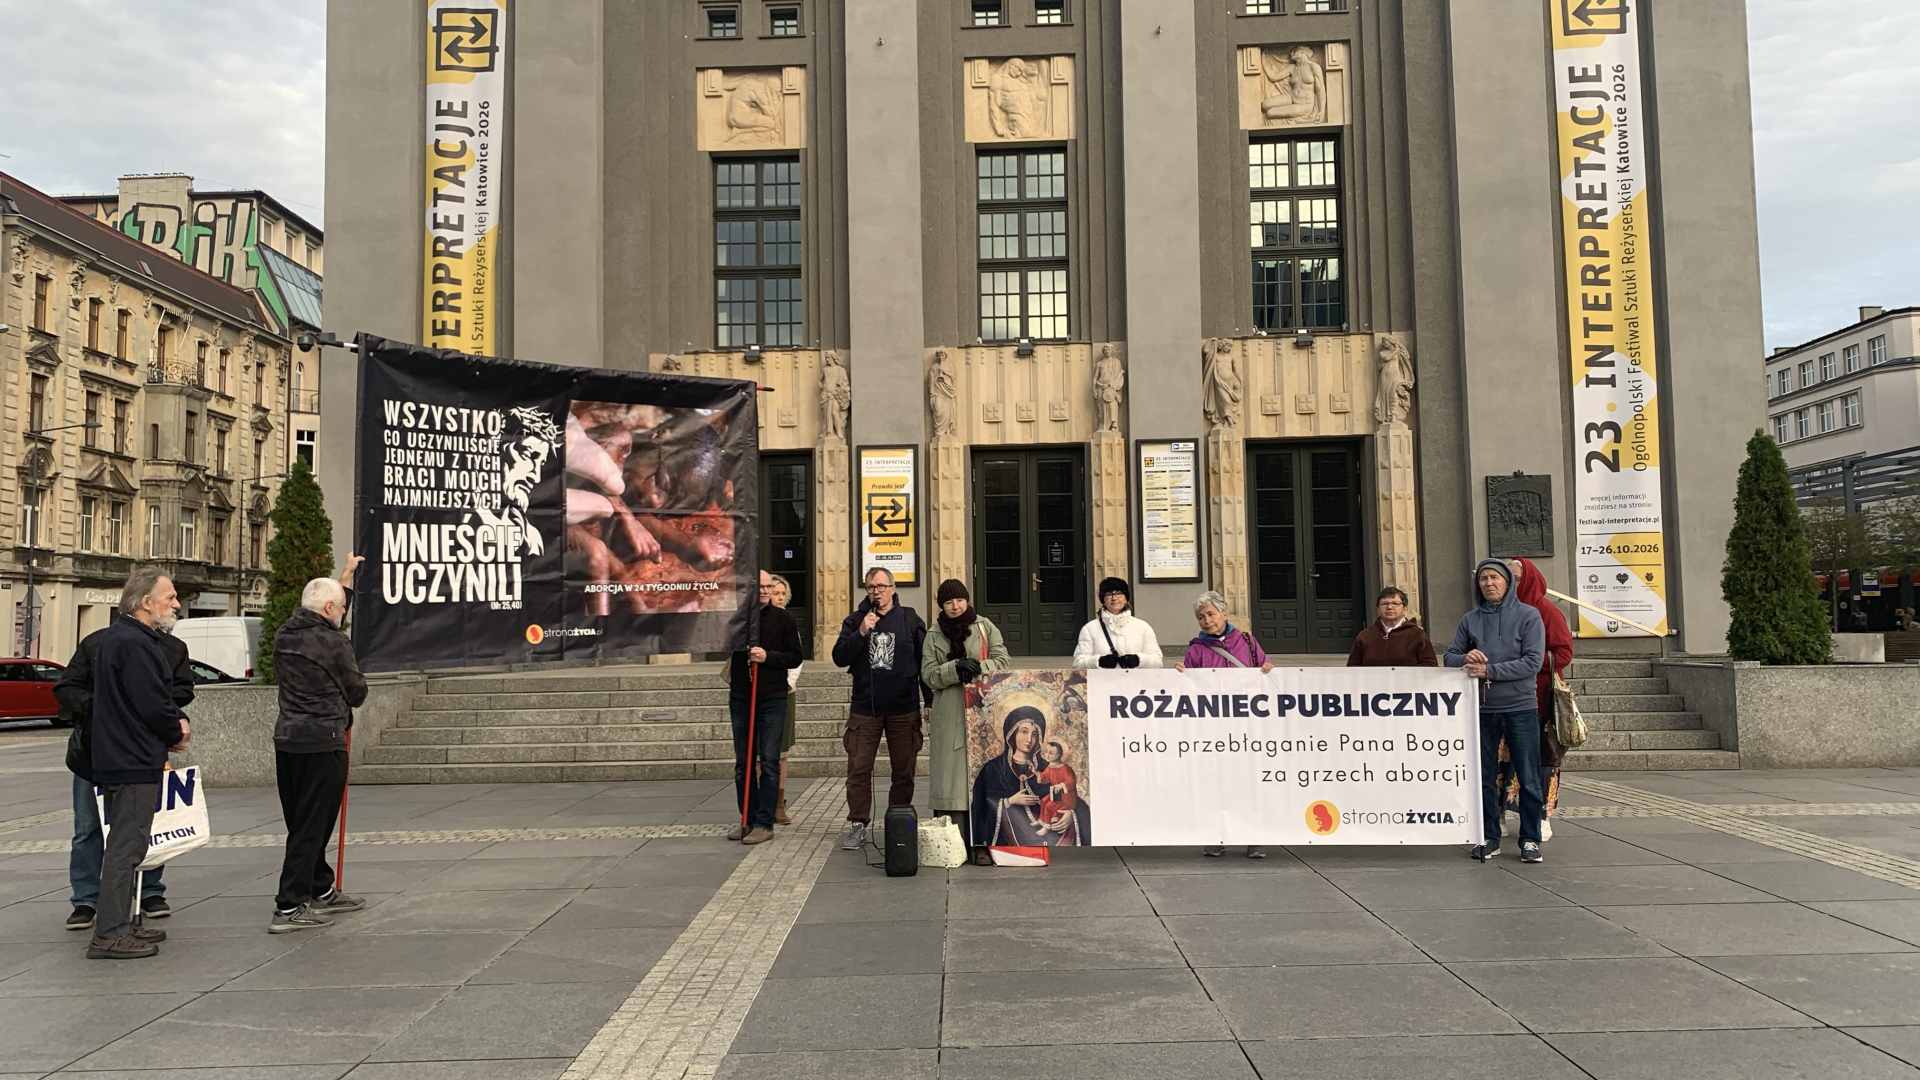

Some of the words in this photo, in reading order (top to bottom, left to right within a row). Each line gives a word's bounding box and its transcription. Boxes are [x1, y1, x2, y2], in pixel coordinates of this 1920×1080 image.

[1612, 64, 1626, 102] 2026
[479, 100, 490, 138] 2026
[1613, 107, 1630, 173] Katowice
[476, 143, 488, 207] Katowice
[1568, 64, 1616, 388] INTERPRETACJE
[1617, 178, 1637, 264] Reżyserskiej
[472, 211, 489, 295] Reżyserskiej
[1621, 269, 1639, 312] Sztuki
[471, 299, 485, 342] Sztuki
[1624, 316, 1642, 374] Festiwal
[383, 399, 501, 435] WSZYSTKO
[1628, 379, 1650, 472] Ogólnopolski
[384, 429, 400, 446] CO
[407, 432, 500, 454] UCZYNILIŚCIE
[385, 447, 445, 468] JEDNEMU
[452, 453, 460, 469] Z
[466, 454, 501, 471] TYCH
[384, 465, 435, 488] BRACI
[445, 469, 501, 491] MOICH
[383, 487, 501, 510] NAJMNIEJSZYCH
[1612, 493, 1647, 502] informacji
[383, 513, 523, 563] MNIEŚCIE
[1579, 516, 1660, 526] festiwal-interpretacje.pl
[382, 562, 522, 605] UCZYNILI
[584, 584, 624, 595] ABORCJA
[625, 584, 633, 592] W
[634, 584, 644, 592] 24
[646, 582, 691, 592] TYGODNIU
[692, 580, 718, 591] ŻYCIA
[1109, 689, 1271, 719] RÓŻANIEC
[1276, 692, 1462, 718] PUBLICZNY
[1122, 733, 1168, 759] jako
[1178, 733, 1328, 758] przebłaganie
[1340, 733, 1395, 753] Pana
[1406, 733, 1466, 757] Boga
[1262, 770, 1287, 783] za
[1298, 762, 1375, 788] grzech
[1385, 762, 1467, 787] aborcji
[1342, 808, 1470, 826] stronaŻYCIA.pl
